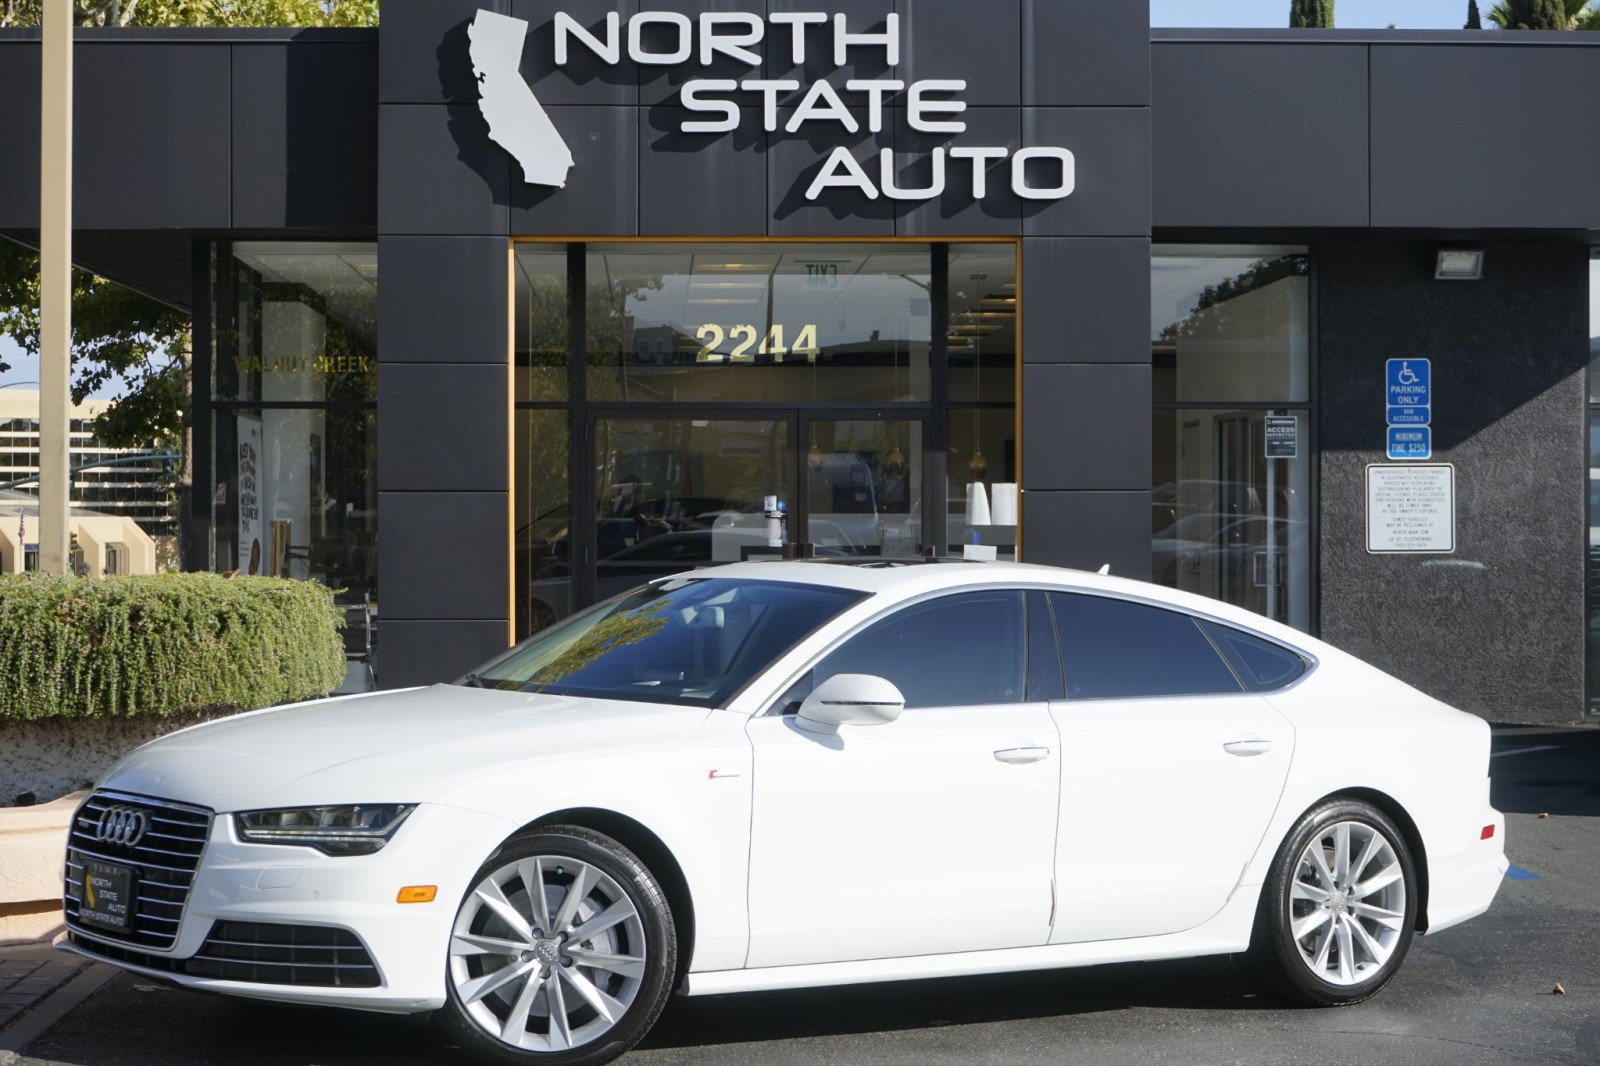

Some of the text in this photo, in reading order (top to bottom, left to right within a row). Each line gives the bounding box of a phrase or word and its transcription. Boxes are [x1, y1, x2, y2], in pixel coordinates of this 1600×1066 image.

[554, 11, 899, 66] NORTH
[680, 79, 966, 132] STATE
[805, 146, 1075, 200] AUTO
[696, 323, 821, 363] 2244
[232, 355, 369, 373] WALNUT CREEK
[1390, 386, 1427, 394] PARKING
[1397, 396, 1419, 404] ONLY
[1395, 432, 1423, 441] MINIMUM
[1391, 443, 1426, 453] FINE $250
[91, 877, 112, 888] NORTH
[99, 890, 118, 901] STATE
[107, 903, 126, 914] AUTO
